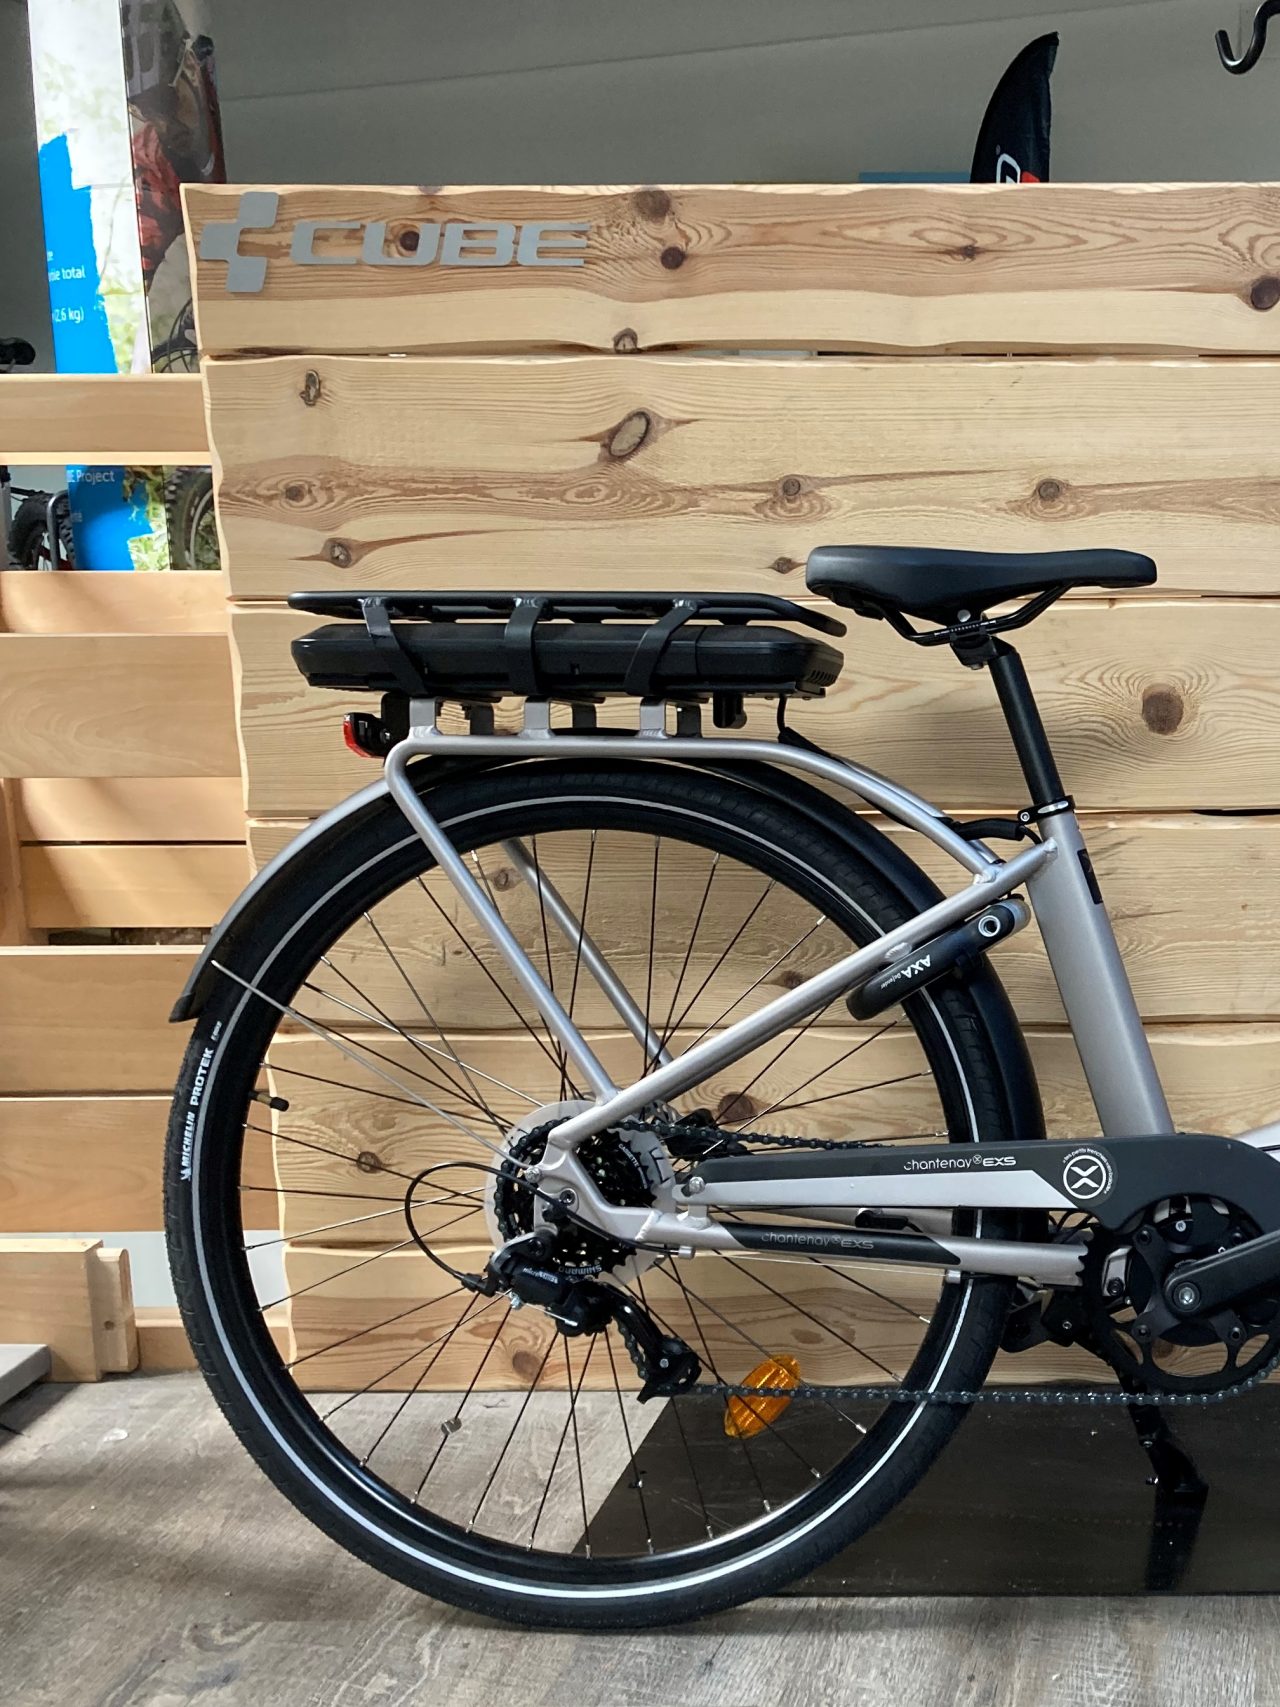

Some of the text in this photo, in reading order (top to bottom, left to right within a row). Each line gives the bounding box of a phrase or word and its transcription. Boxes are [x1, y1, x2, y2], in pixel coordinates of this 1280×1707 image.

[290, 222, 592, 267] CUBE
[62, 265, 86, 280] total
[76, 469, 116, 485] Project
[881, 954, 931, 990] AXA Defender
[181, 1047, 215, 1167] MICHELIN PROTEK
[903, 1156, 1017, 1171] chantenay EXS
[761, 1231, 875, 1250] chantenay EXS
